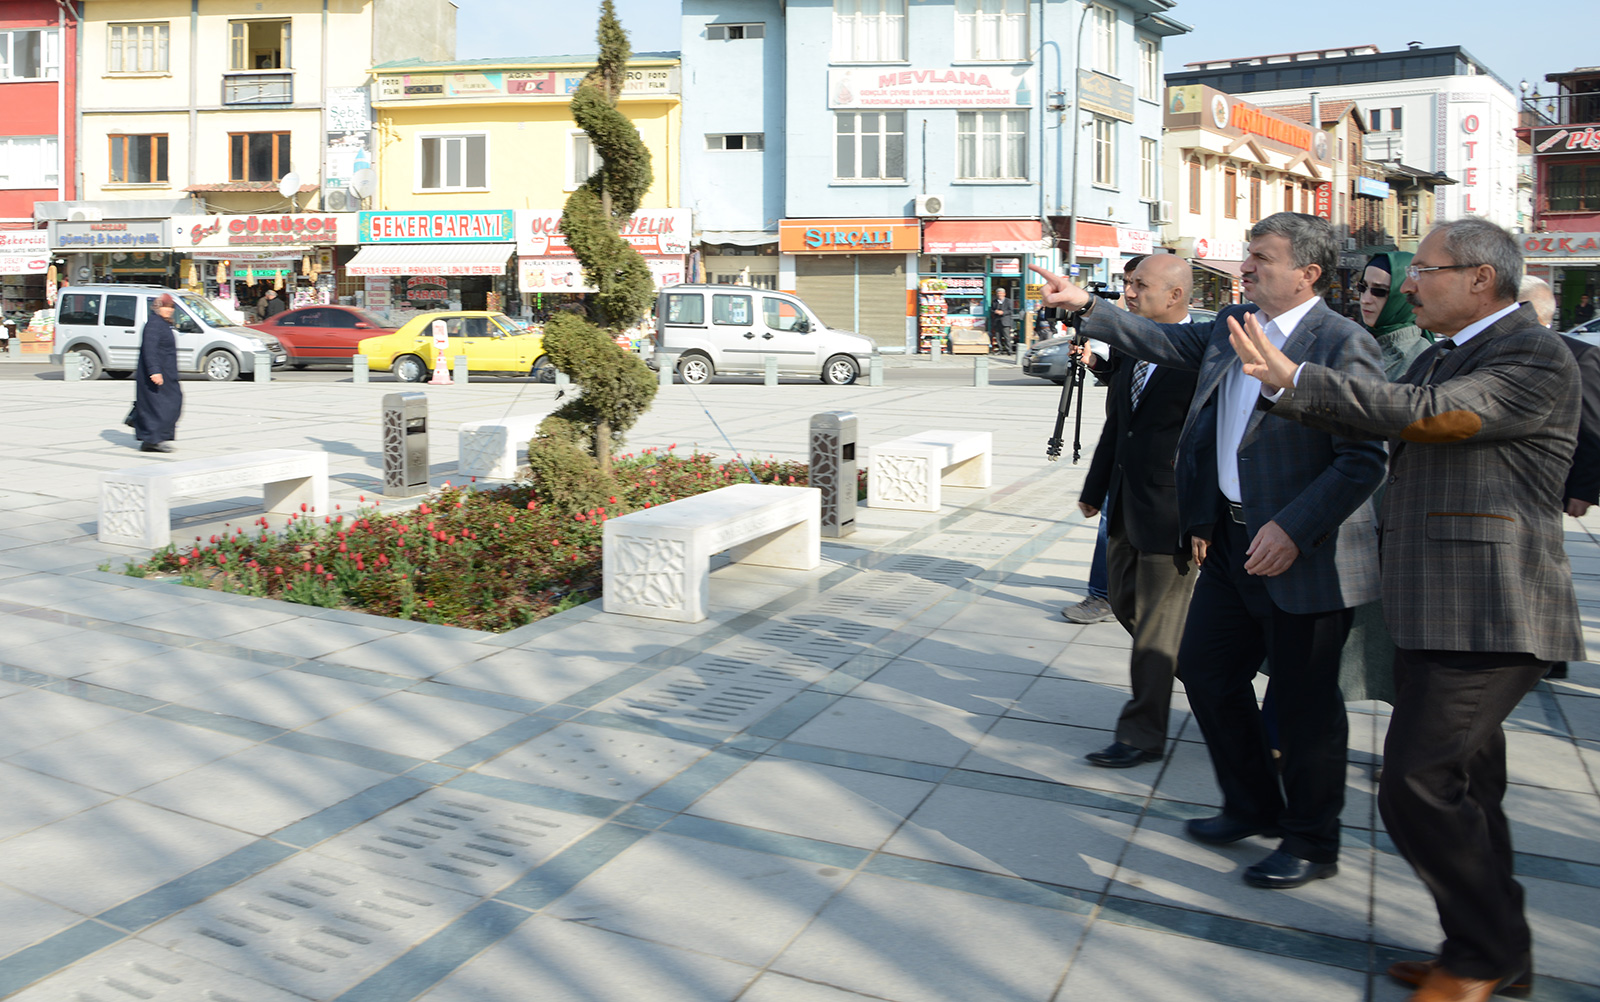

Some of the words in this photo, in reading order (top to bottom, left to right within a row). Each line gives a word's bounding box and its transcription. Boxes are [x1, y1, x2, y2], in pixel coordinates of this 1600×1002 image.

[516, 81, 544, 92] HDC
[878, 70, 992, 88] MEVLANA
[406, 85, 443, 95] GOLD
[1463, 114, 1480, 212] OTEL
[228, 215, 338, 234] GÜMÜŞOK
[434, 215, 500, 237] SARAYI
[59, 232, 95, 247] gümüş
[97, 232, 105, 244] &
[106, 233, 160, 247] hediyelik
[805, 228, 893, 247] SIRÇALI
